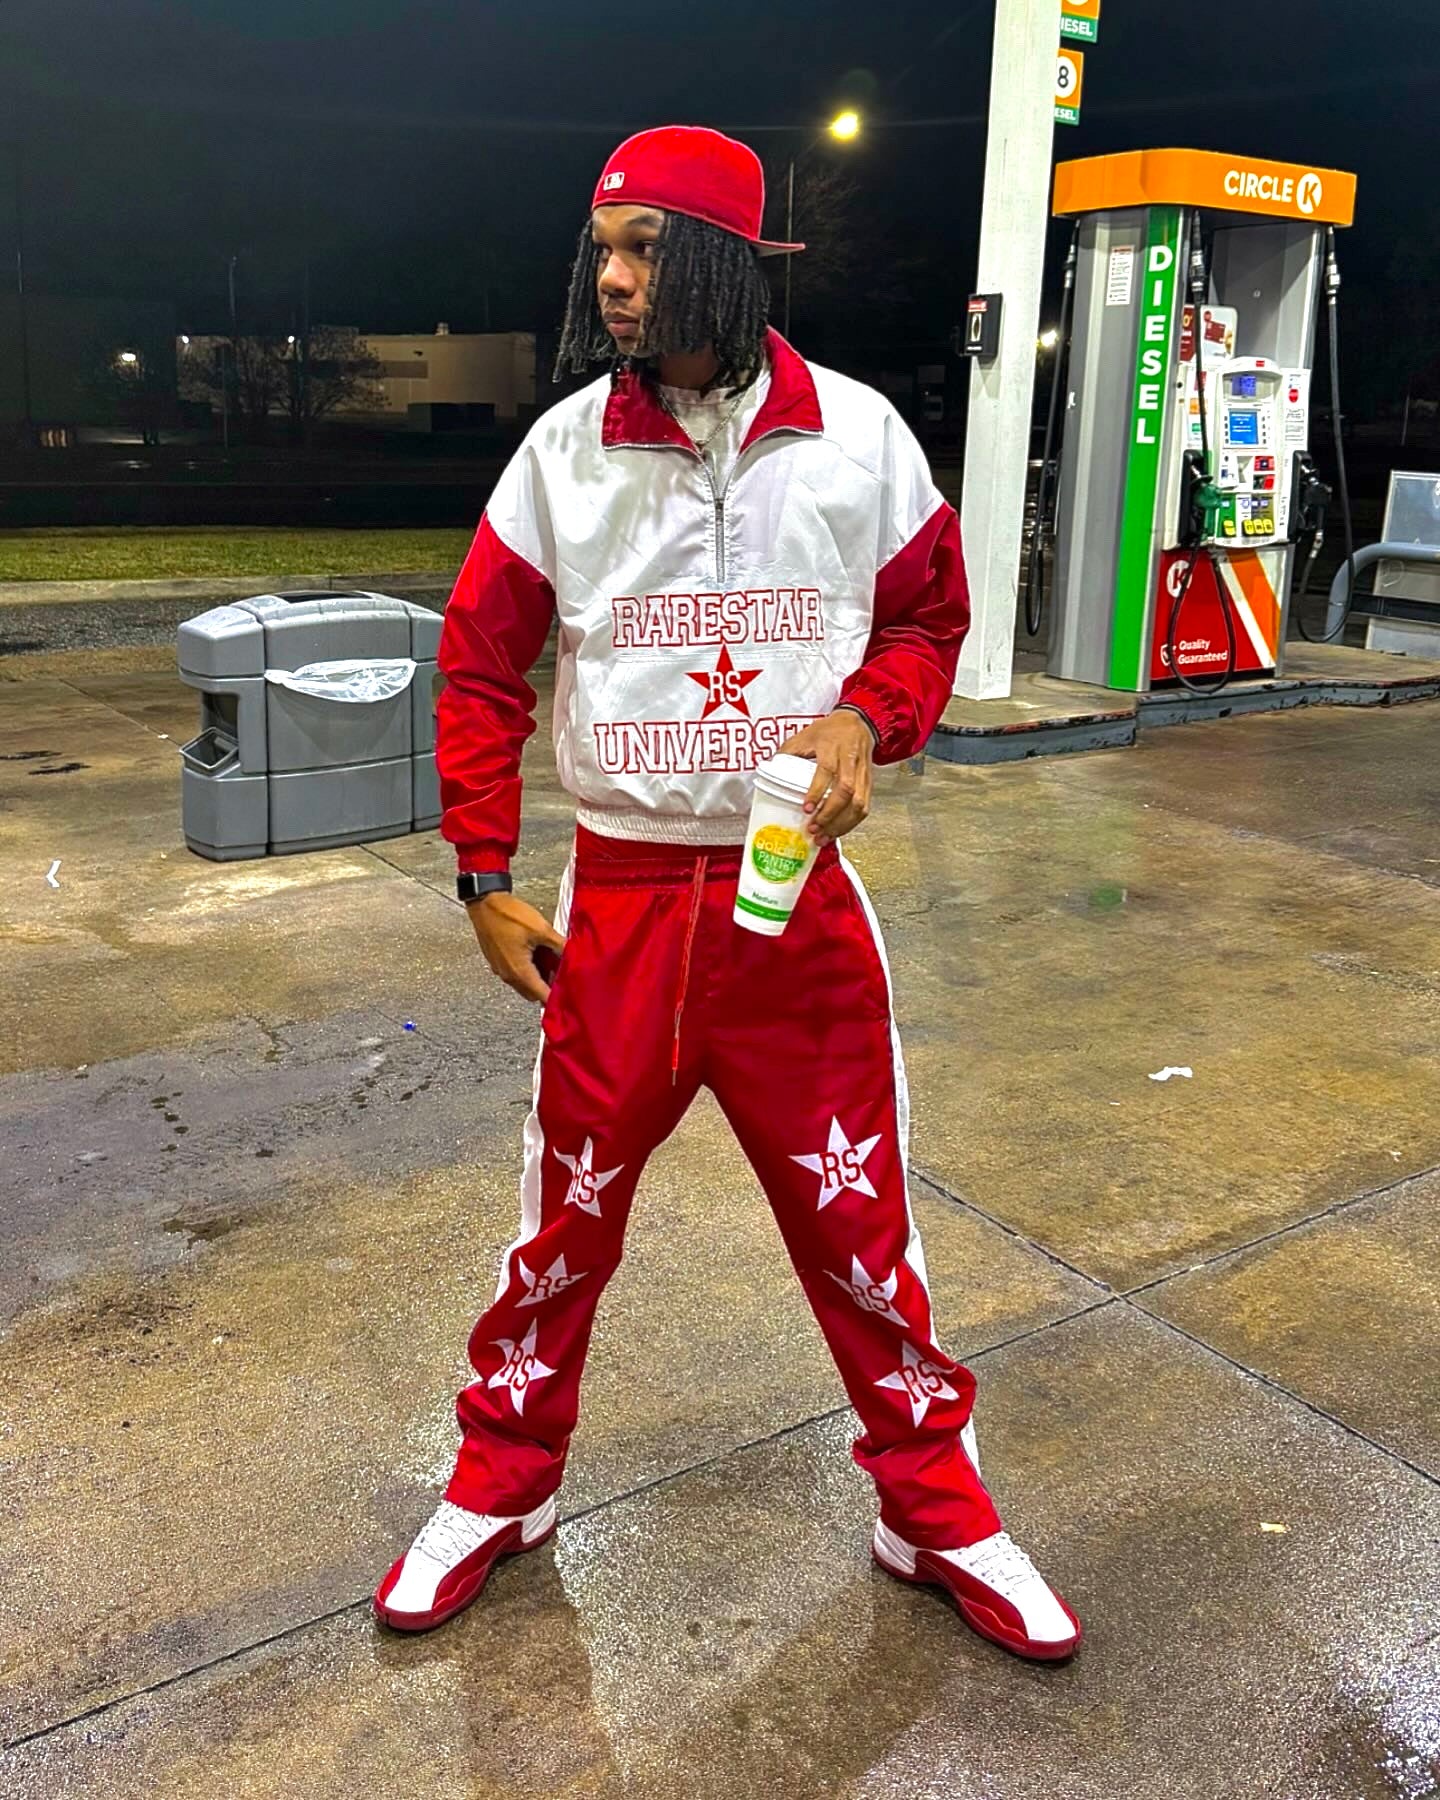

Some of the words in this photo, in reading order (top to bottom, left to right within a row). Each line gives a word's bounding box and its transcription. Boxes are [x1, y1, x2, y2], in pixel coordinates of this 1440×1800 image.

[1060, 17, 1093, 36] IESEL
[1057, 65, 1069, 88] 8
[1054, 107, 1076, 120] ESEL
[1224, 170, 1294, 203] CIRCLE
[1296, 173, 1322, 214] K
[1136, 245, 1173, 444] DIESEL
[612, 588, 824, 647] RARESTAR
[1178, 650, 1228, 664] Guaranteed
[1179, 638, 1210, 650] Quality
[708, 671, 742, 703] RS
[594, 714, 827, 774] UNIVERSI
[758, 850, 798, 871] PANTRY
[573, 1159, 598, 1204] RS
[820, 1147, 861, 1189] RS
[530, 1276, 573, 1298] RS
[851, 1285, 890, 1312] RS
[500, 1344, 535, 1392] RS
[898, 1360, 943, 1404] RS
